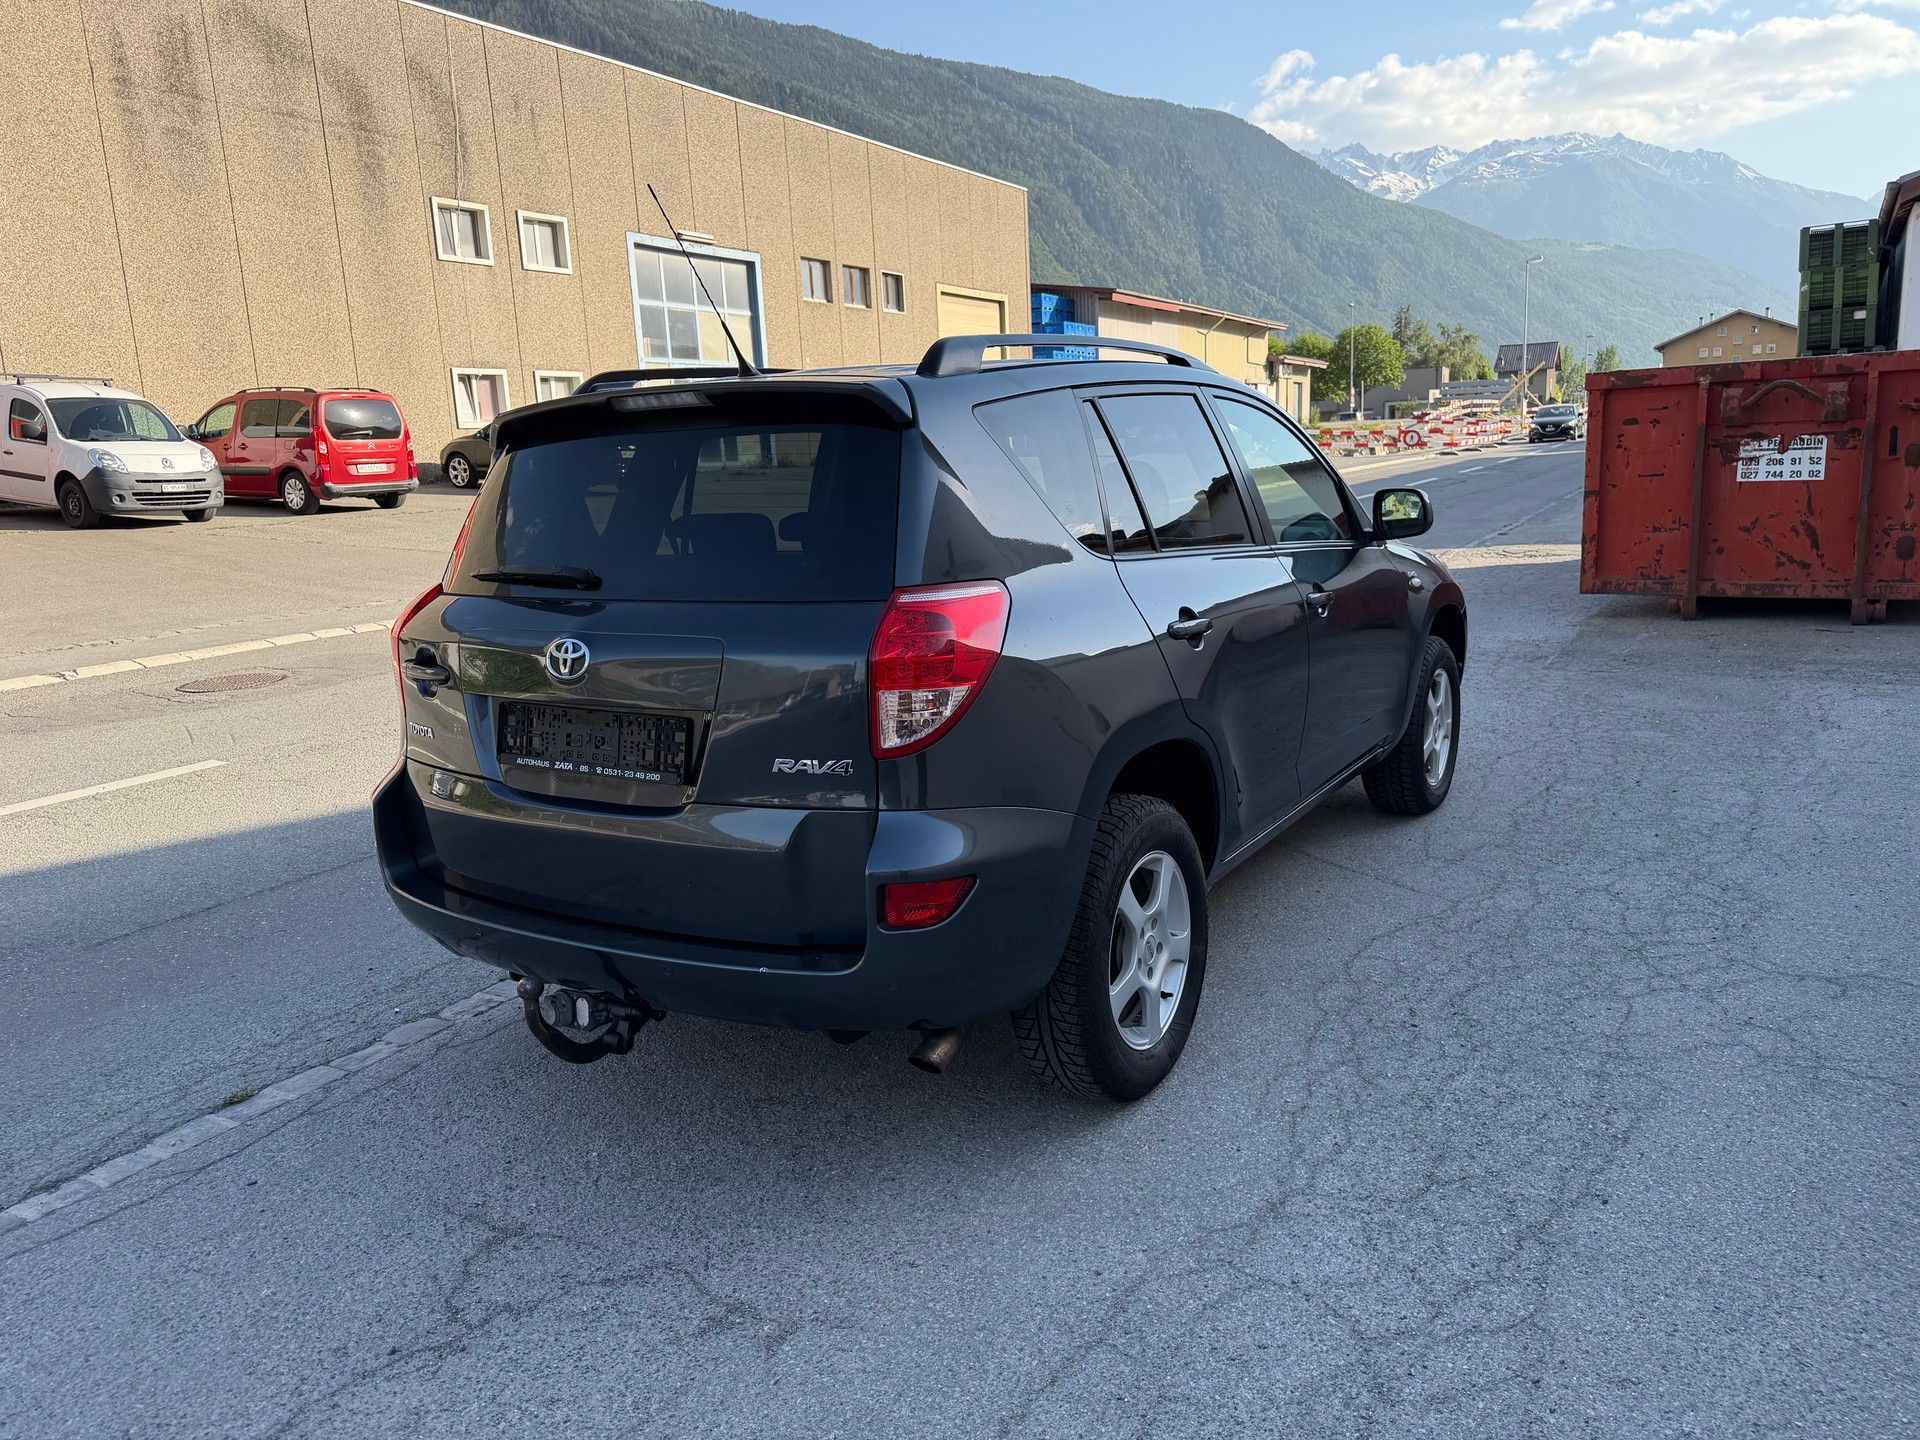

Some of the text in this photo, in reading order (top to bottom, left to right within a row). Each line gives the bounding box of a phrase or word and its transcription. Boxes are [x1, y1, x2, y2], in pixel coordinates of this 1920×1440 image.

[1768, 437, 1823, 447] PEAUDIN
[1741, 457, 1822, 467] 079 206 91 52
[1740, 469, 1821, 480] 027 744 20 02
[409, 721, 434, 739] TOYOTA
[516, 757, 550, 768] AUTOHAUS
[554, 761, 573, 771] ZATA
[579, 765, 589, 773] BS
[624, 770, 634, 778] 23
[635, 771, 645, 779] 49
[645, 772, 661, 781] 200
[772, 758, 854, 776] RAV4
